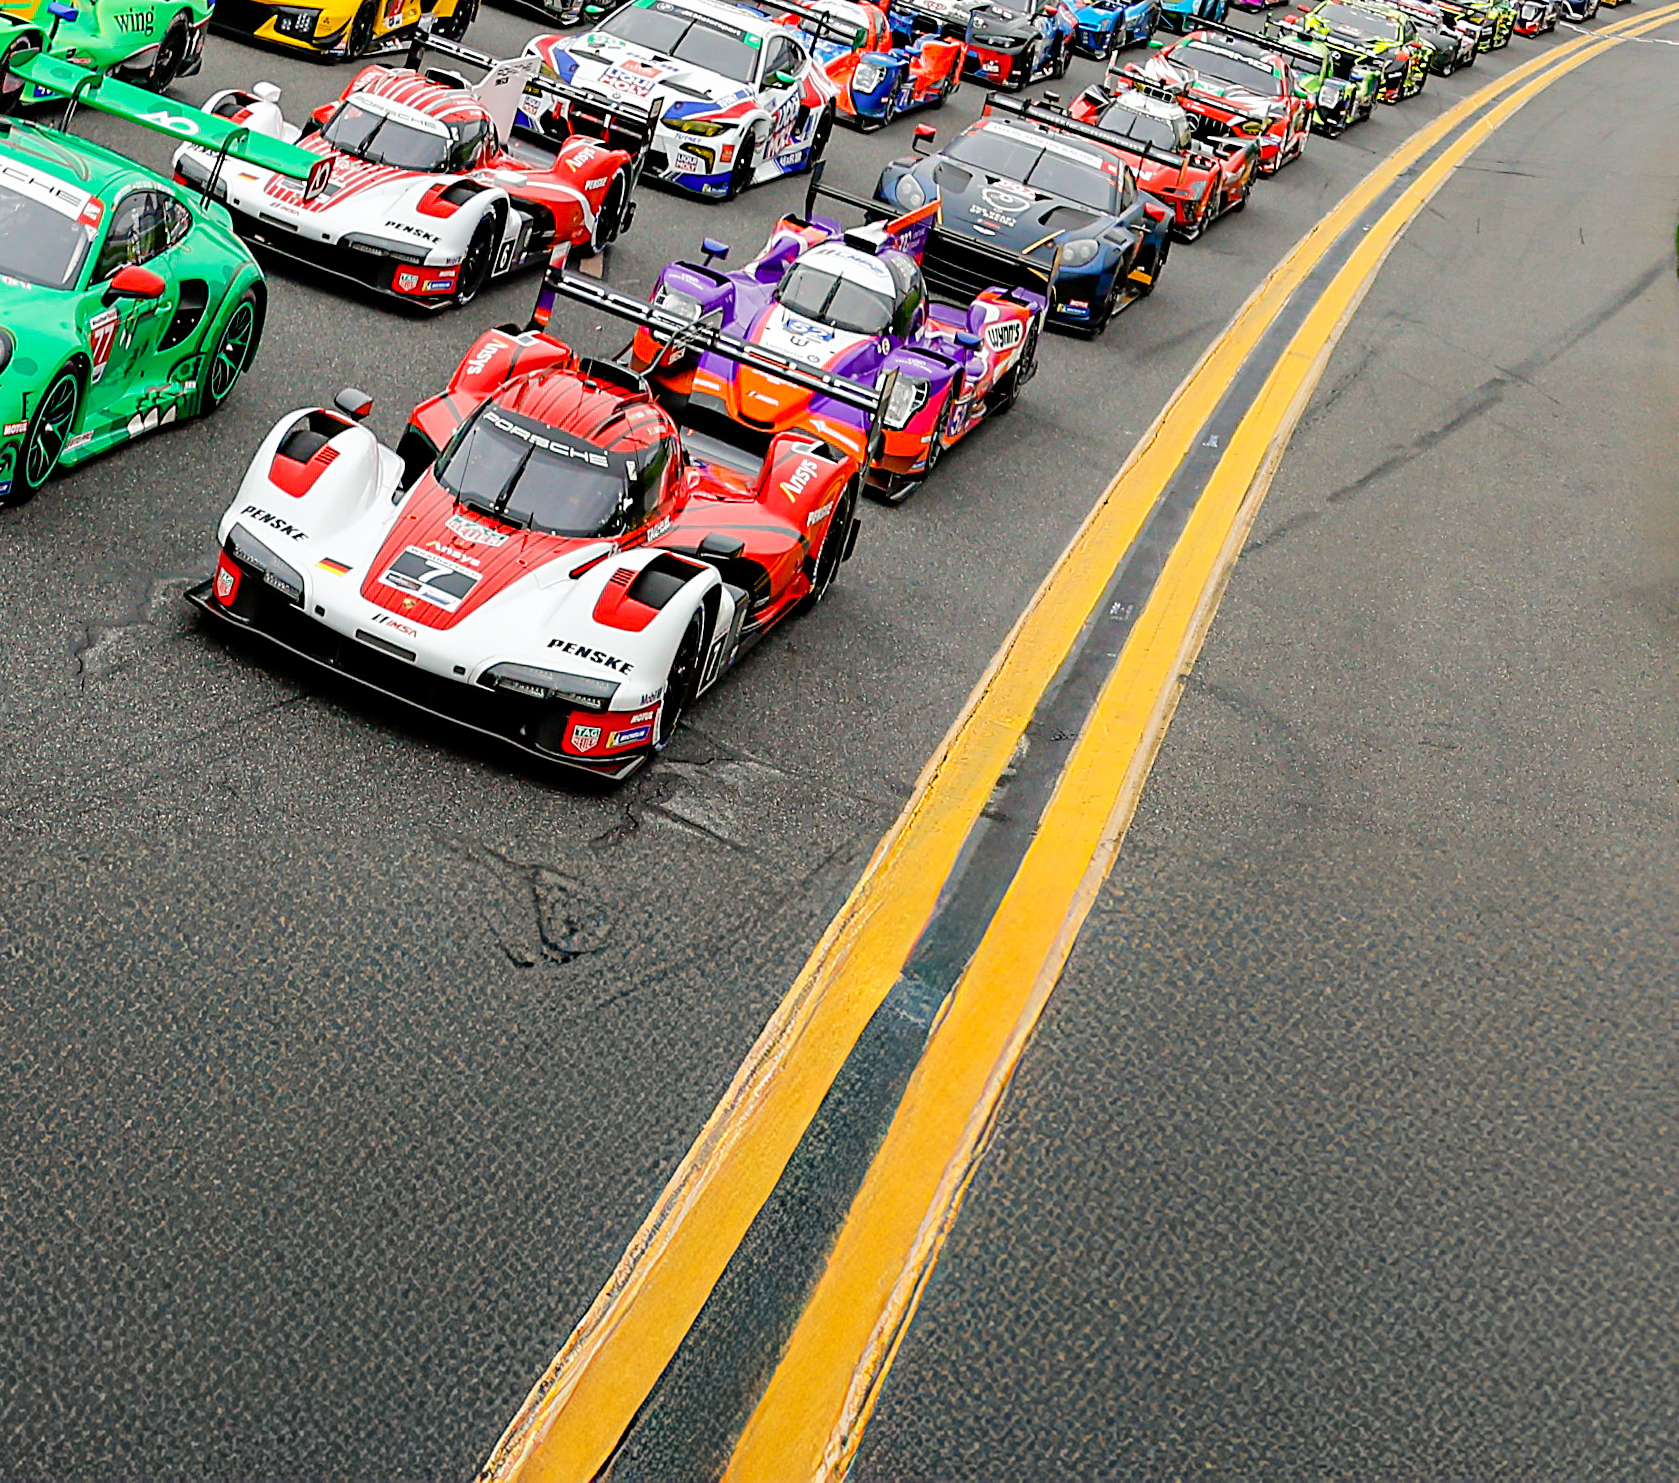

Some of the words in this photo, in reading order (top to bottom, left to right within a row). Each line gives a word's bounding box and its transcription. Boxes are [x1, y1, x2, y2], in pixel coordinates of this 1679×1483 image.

[113, 10, 155, 36] wing
[692, 12, 742, 36] Motorsport
[597, 73, 654, 98] MOLY
[603, 66, 656, 92] LIQUI
[136, 110, 200, 136] AO
[354, 94, 438, 129] PORSCHE
[564, 146, 596, 173] Ansys
[675, 160, 697, 173] MOLY
[677, 152, 698, 165] LIQUI
[584, 175, 608, 191] PENSKE
[384, 220, 442, 246] PENSKE
[499, 243, 511, 267] 6
[92, 324, 116, 365] 77
[466, 338, 509, 376] Ansys
[482, 410, 610, 469] PORSCHE
[779, 458, 818, 504] Ansys
[240, 504, 310, 543] PENSKE
[806, 500, 834, 527] PENSKE
[425, 540, 482, 568] Ansys
[416, 559, 455, 583] 7
[386, 619, 419, 639] IMSA
[546, 638, 636, 677] PENSKE
[576, 727, 599, 737] TAG
